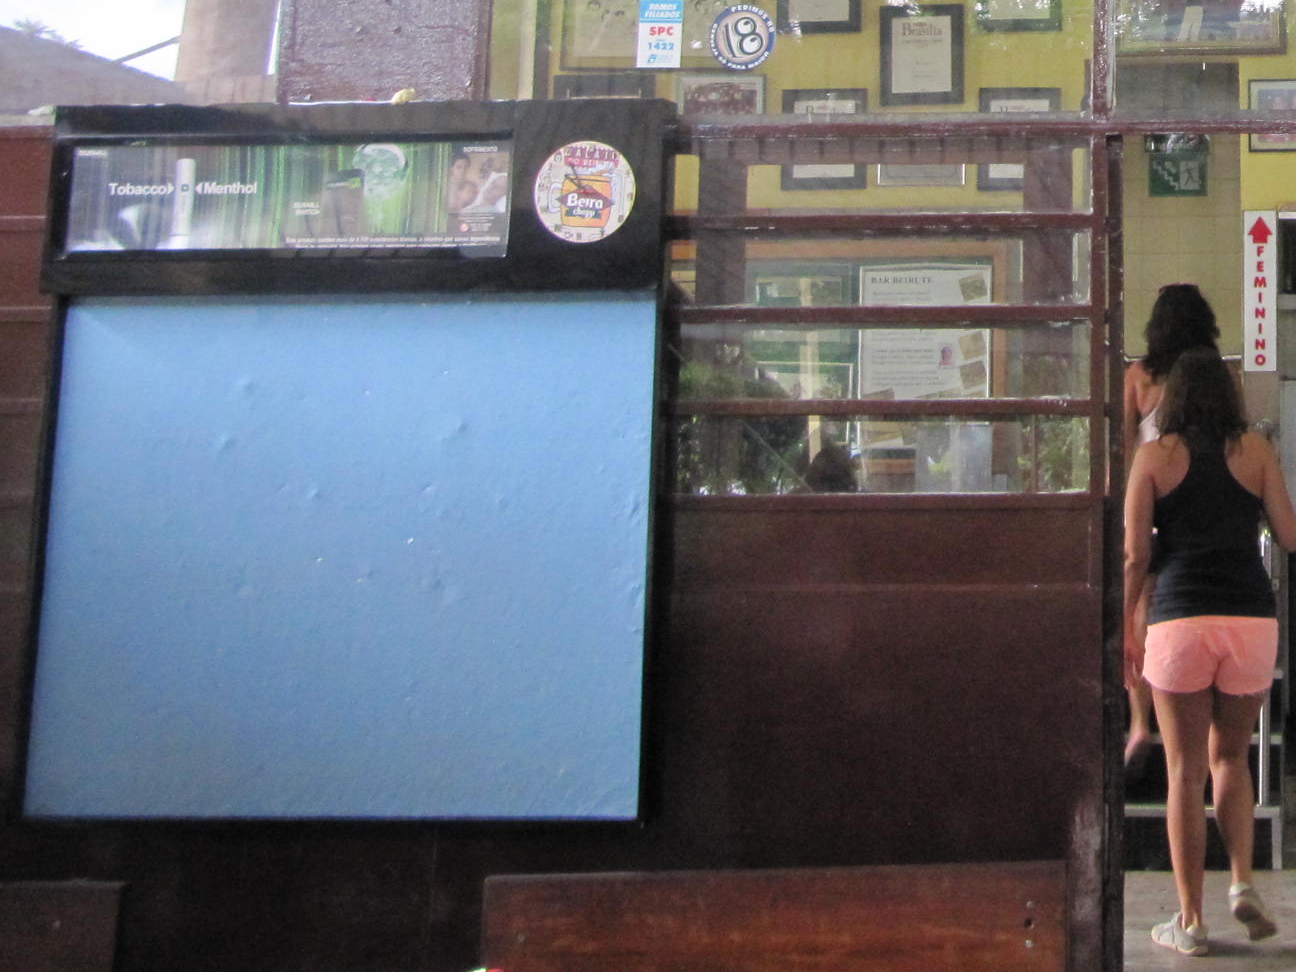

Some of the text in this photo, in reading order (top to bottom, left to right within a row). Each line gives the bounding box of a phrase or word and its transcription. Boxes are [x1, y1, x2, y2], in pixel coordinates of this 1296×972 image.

[731, 4, 768, 19] PEDIMOS
[649, 26, 675, 36] SPC
[723, 16, 764, 57] 18
[647, 42, 675, 50] 1422
[108, 181, 257, 196] Tobacco Menthol
[871, 277, 890, 285] BAR
[1254, 245, 1268, 367] FEMININO
